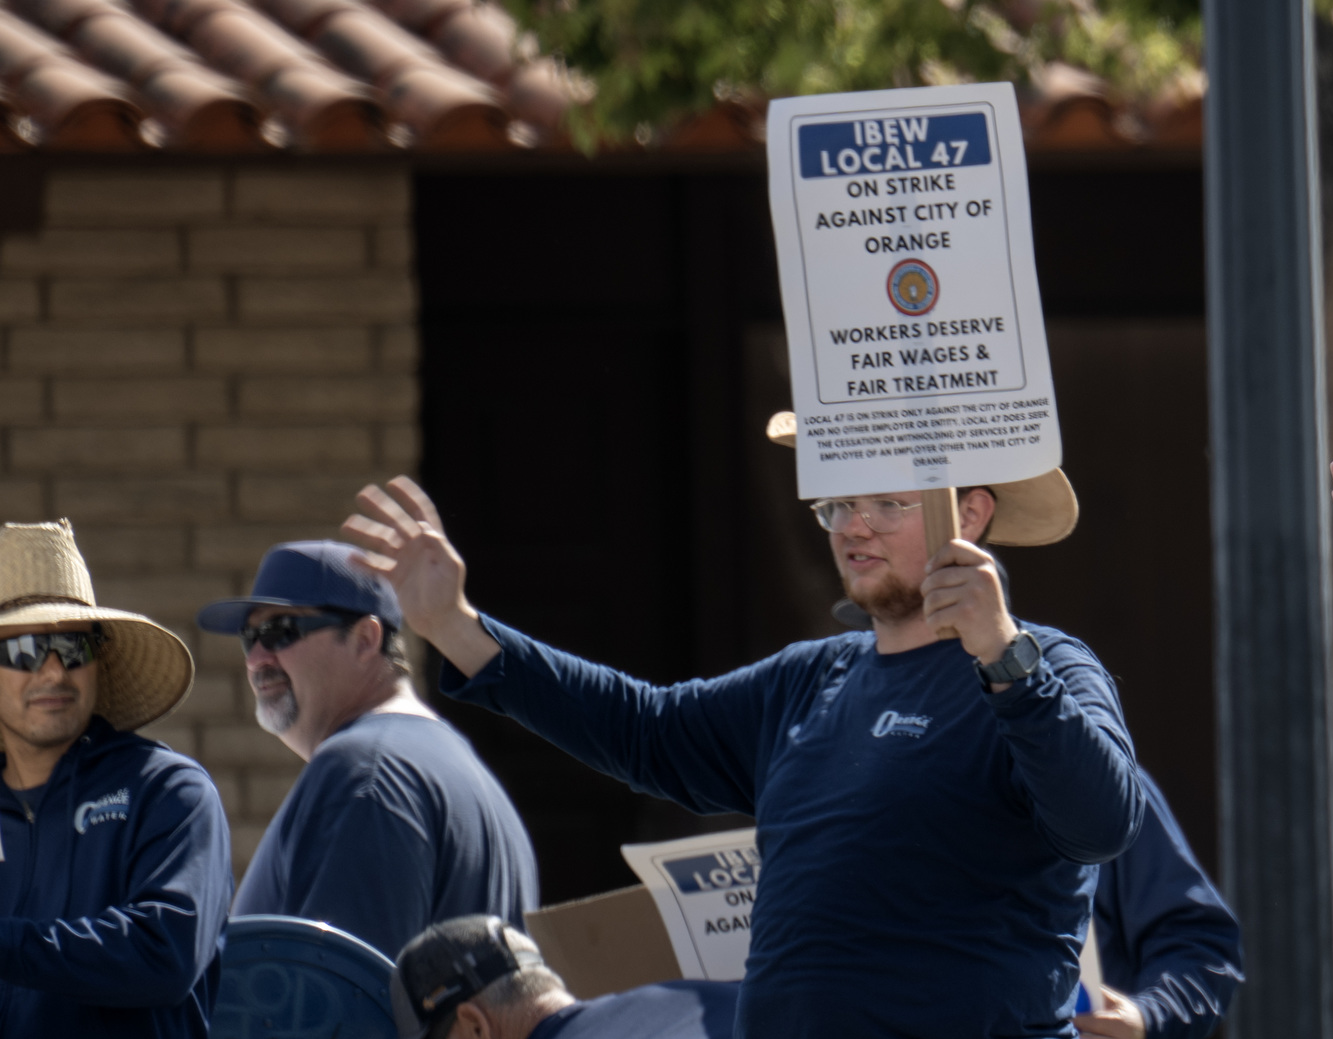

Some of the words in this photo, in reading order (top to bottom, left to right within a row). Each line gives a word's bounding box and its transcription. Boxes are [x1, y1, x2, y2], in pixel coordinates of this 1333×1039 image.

[853, 115, 932, 145] IBEW
[821, 144, 922, 175] LOCAL
[931, 140, 968, 166] 47
[846, 179, 878, 198] ON
[886, 173, 955, 195] STRIKE
[815, 205, 906, 229] AGAINST
[914, 202, 958, 221] CITY
[965, 199, 991, 217] OF
[864, 231, 950, 254] ORANGE
[829, 323, 922, 345] WORKERS
[927, 316, 1004, 337] DESERVE
[851, 351, 894, 370] FAIR
[898, 345, 969, 365] WAGES
[976, 344, 990, 360] &
[847, 378, 888, 396] FAIR
[892, 370, 997, 392] TREATMENT
[725, 891, 753, 906] ON
